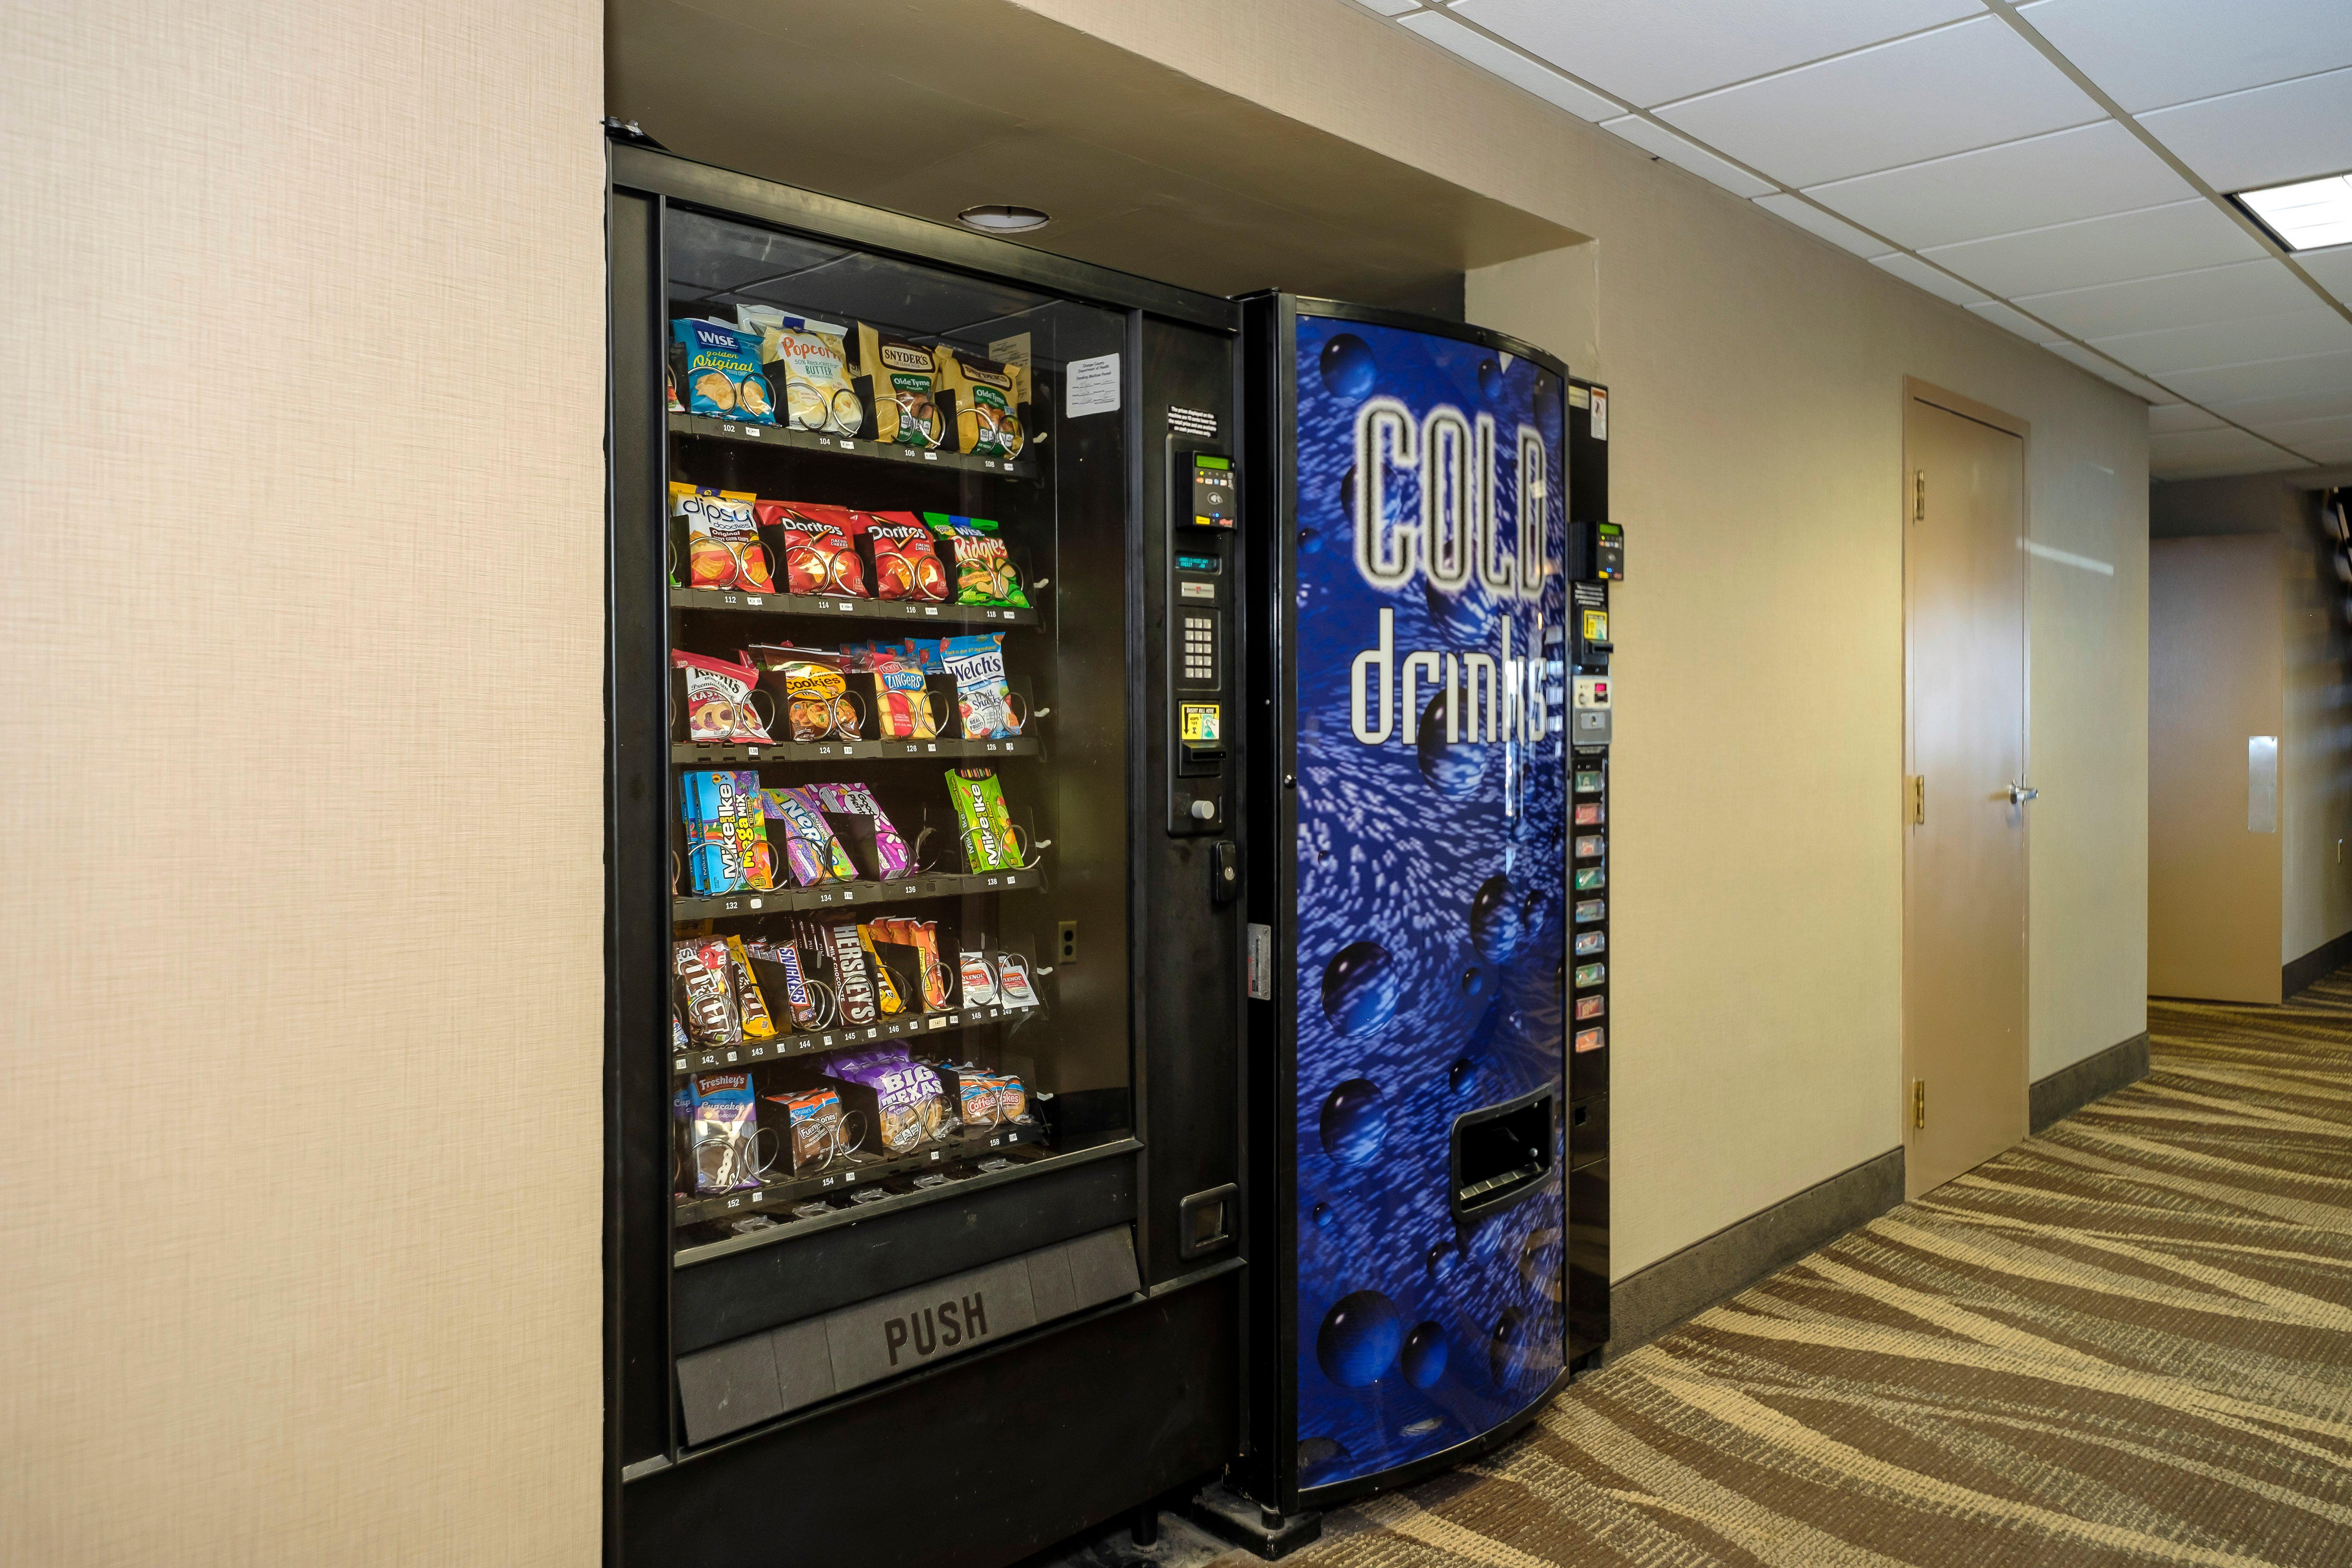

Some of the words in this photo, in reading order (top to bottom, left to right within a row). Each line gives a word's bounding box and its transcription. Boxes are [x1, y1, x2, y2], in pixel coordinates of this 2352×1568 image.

[697, 330, 736, 347] WISE
[781, 337, 841, 363] Popcorn
[885, 349, 929, 365] SNYDER'S
[693, 355, 754, 372] Original
[806, 366, 833, 376] BUTTER
[1355, 398, 1547, 597] COLD
[683, 496, 753, 527] dipsy
[714, 521, 751, 529] doodles
[782, 518, 843, 535] Doritos
[868, 526, 926, 540] Doritos
[955, 527, 985, 536] WISE
[951, 535, 1008, 569] Ridgies
[948, 656, 1001, 682] Welch's
[1351, 608, 1547, 746] drinks
[786, 677, 841, 690] Cookies
[970, 722, 984, 730] FRUIT!
[718, 783, 733, 816] Ike
[736, 793, 746, 818] Mix
[847, 794, 866, 815] Plent
[857, 793, 877, 816] Good
[971, 783, 987, 813] Ike
[720, 814, 735, 823] and
[737, 818, 755, 868] Mega
[978, 816, 1000, 866] Mike
[722, 822, 738, 879] Mike
[778, 947, 808, 1004] SNICKERS
[833, 925, 876, 1019] HERSHEY'S
[889, 1025, 899, 1033] 146
[751, 1048, 764, 1056] 143
[799, 1040, 811, 1049] 144
[702, 1055, 715, 1063] 142
[699, 1075, 744, 1091] Freshley's
[886, 1065, 934, 1094] BIG
[882, 1080, 943, 1111] TEXAS
[794, 1107, 812, 1116] Drake's
[969, 1096, 997, 1113] Coffee
[799, 1123, 822, 1139] Funny
[823, 1177, 834, 1186] 154
[728, 1198, 740, 1209] 152
[884, 1291, 987, 1367] PUSH
